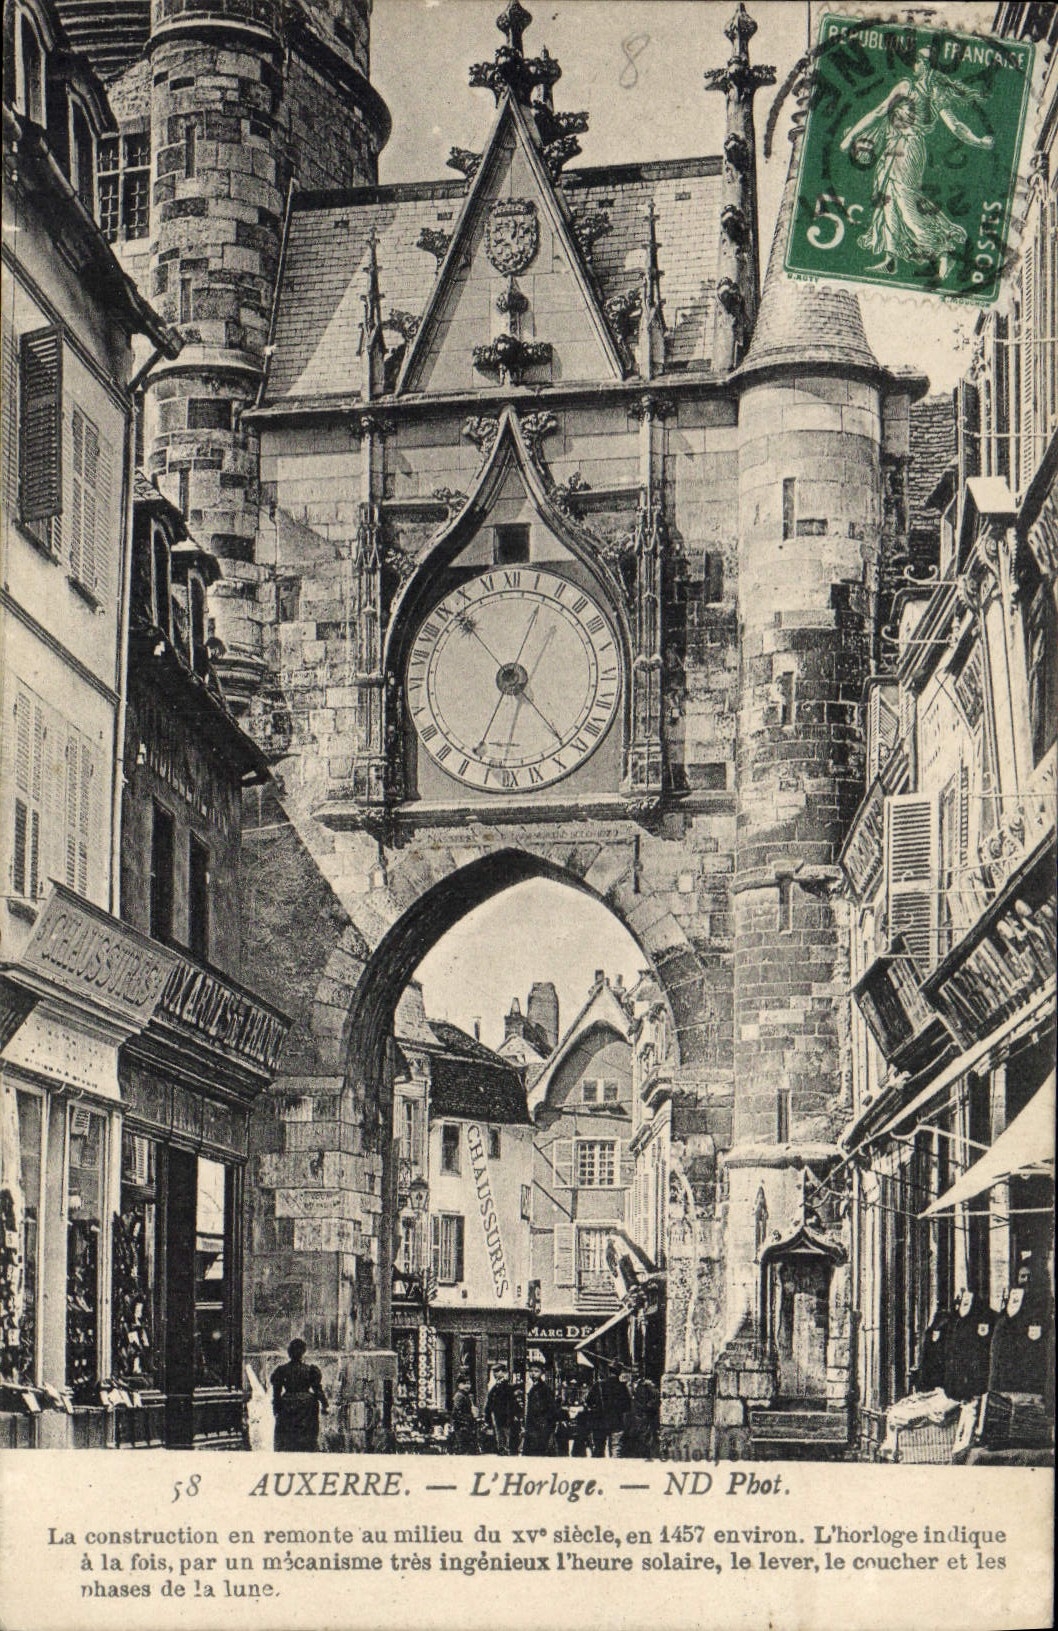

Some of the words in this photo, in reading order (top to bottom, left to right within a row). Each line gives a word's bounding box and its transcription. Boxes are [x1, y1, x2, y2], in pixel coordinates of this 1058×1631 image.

[619, 32, 651, 90] 8
[828, 25, 918, 49] REPUBL
[972, 201, 1003, 284] POSTES
[467, 1123, 510, 1300] CHAUSSURES
